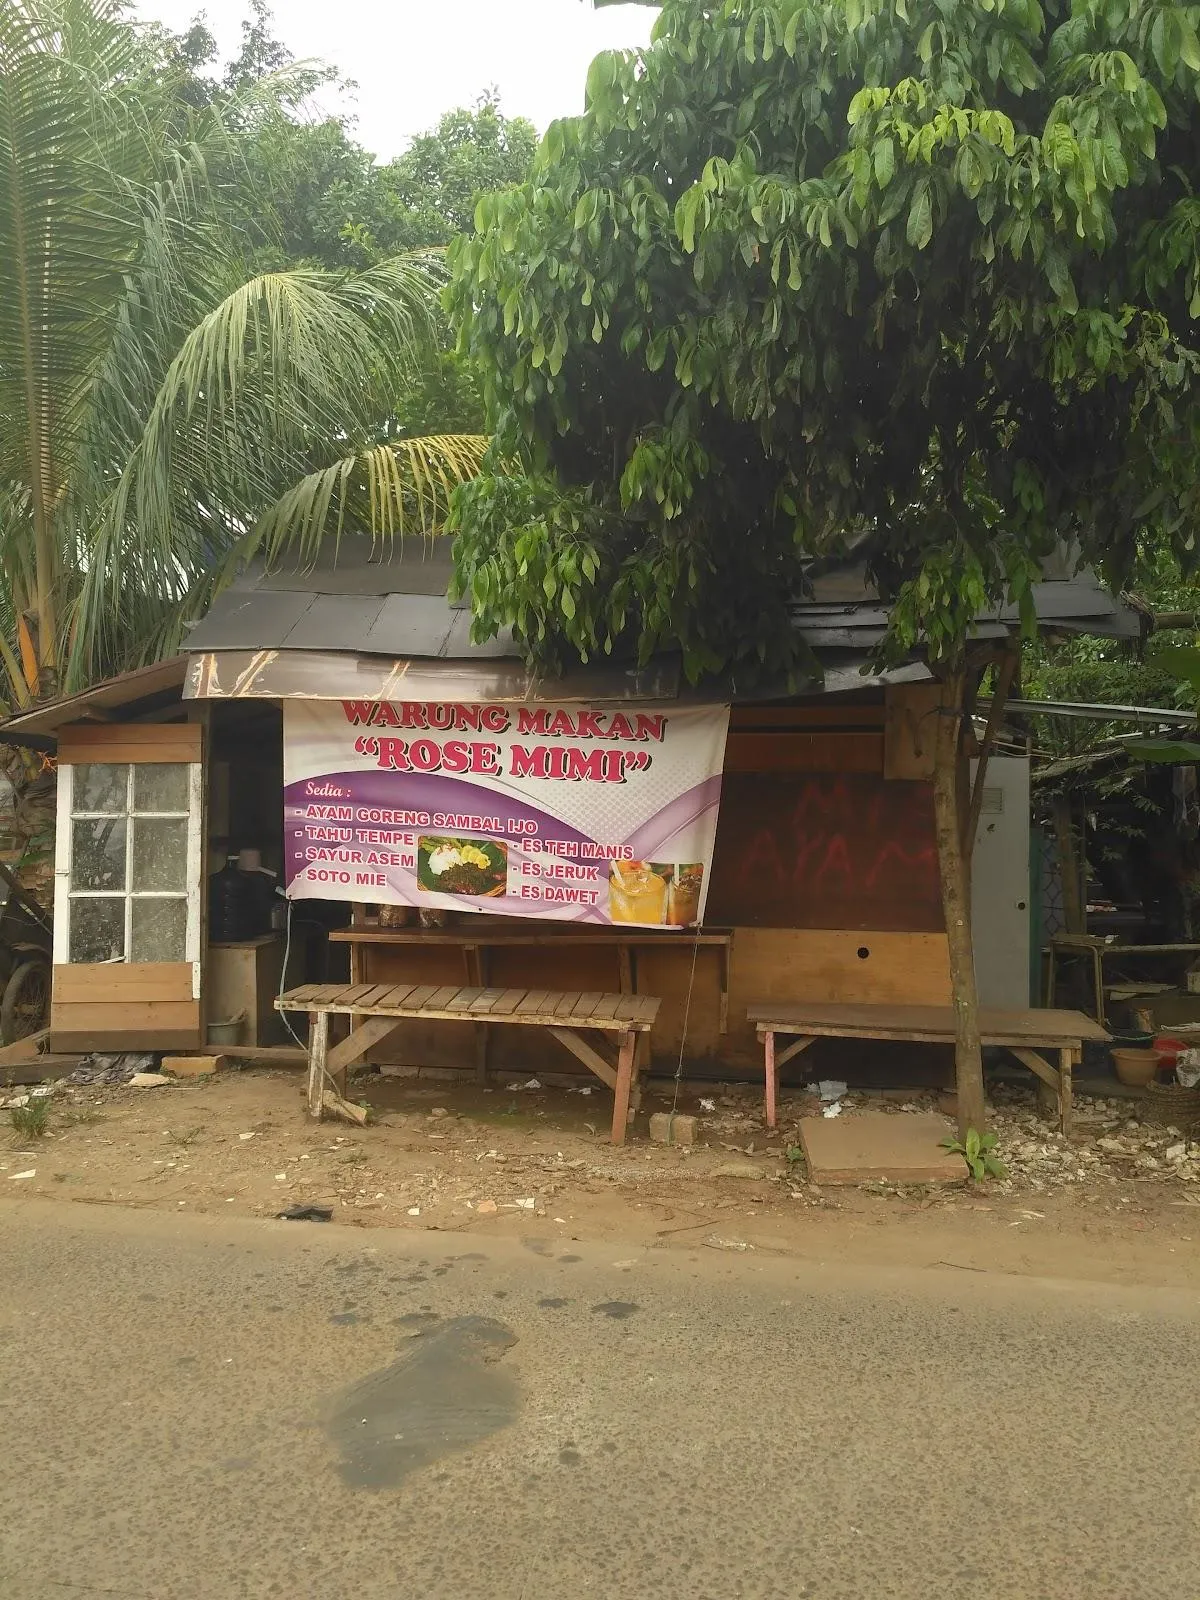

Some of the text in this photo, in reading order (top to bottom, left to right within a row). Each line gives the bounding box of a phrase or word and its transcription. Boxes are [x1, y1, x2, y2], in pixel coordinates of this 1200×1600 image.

[341, 701, 668, 742] WARUNG MAKAN
[305, 782, 343, 797] Sedia
[306, 804, 352, 821] AYAM
[357, 808, 429, 826] GORENG
[434, 812, 504, 832] SAMBAL
[507, 819, 538, 835] IJO
[305, 825, 353, 842] TAHU
[355, 829, 414, 846] TEMPE
[305, 847, 363, 864] SAYUR
[367, 851, 415, 868] ASEM
[522, 839, 543, 853] ES
[545, 841, 578, 857] TEH
[581, 843, 634, 860] MANIS
[306, 868, 352, 885] SOTO
[355, 872, 388, 887] MIE
[521, 862, 542, 877] ES
[544, 864, 600, 881] JERUK
[521, 884, 541, 900] ES
[544, 887, 599, 904] DAWET
